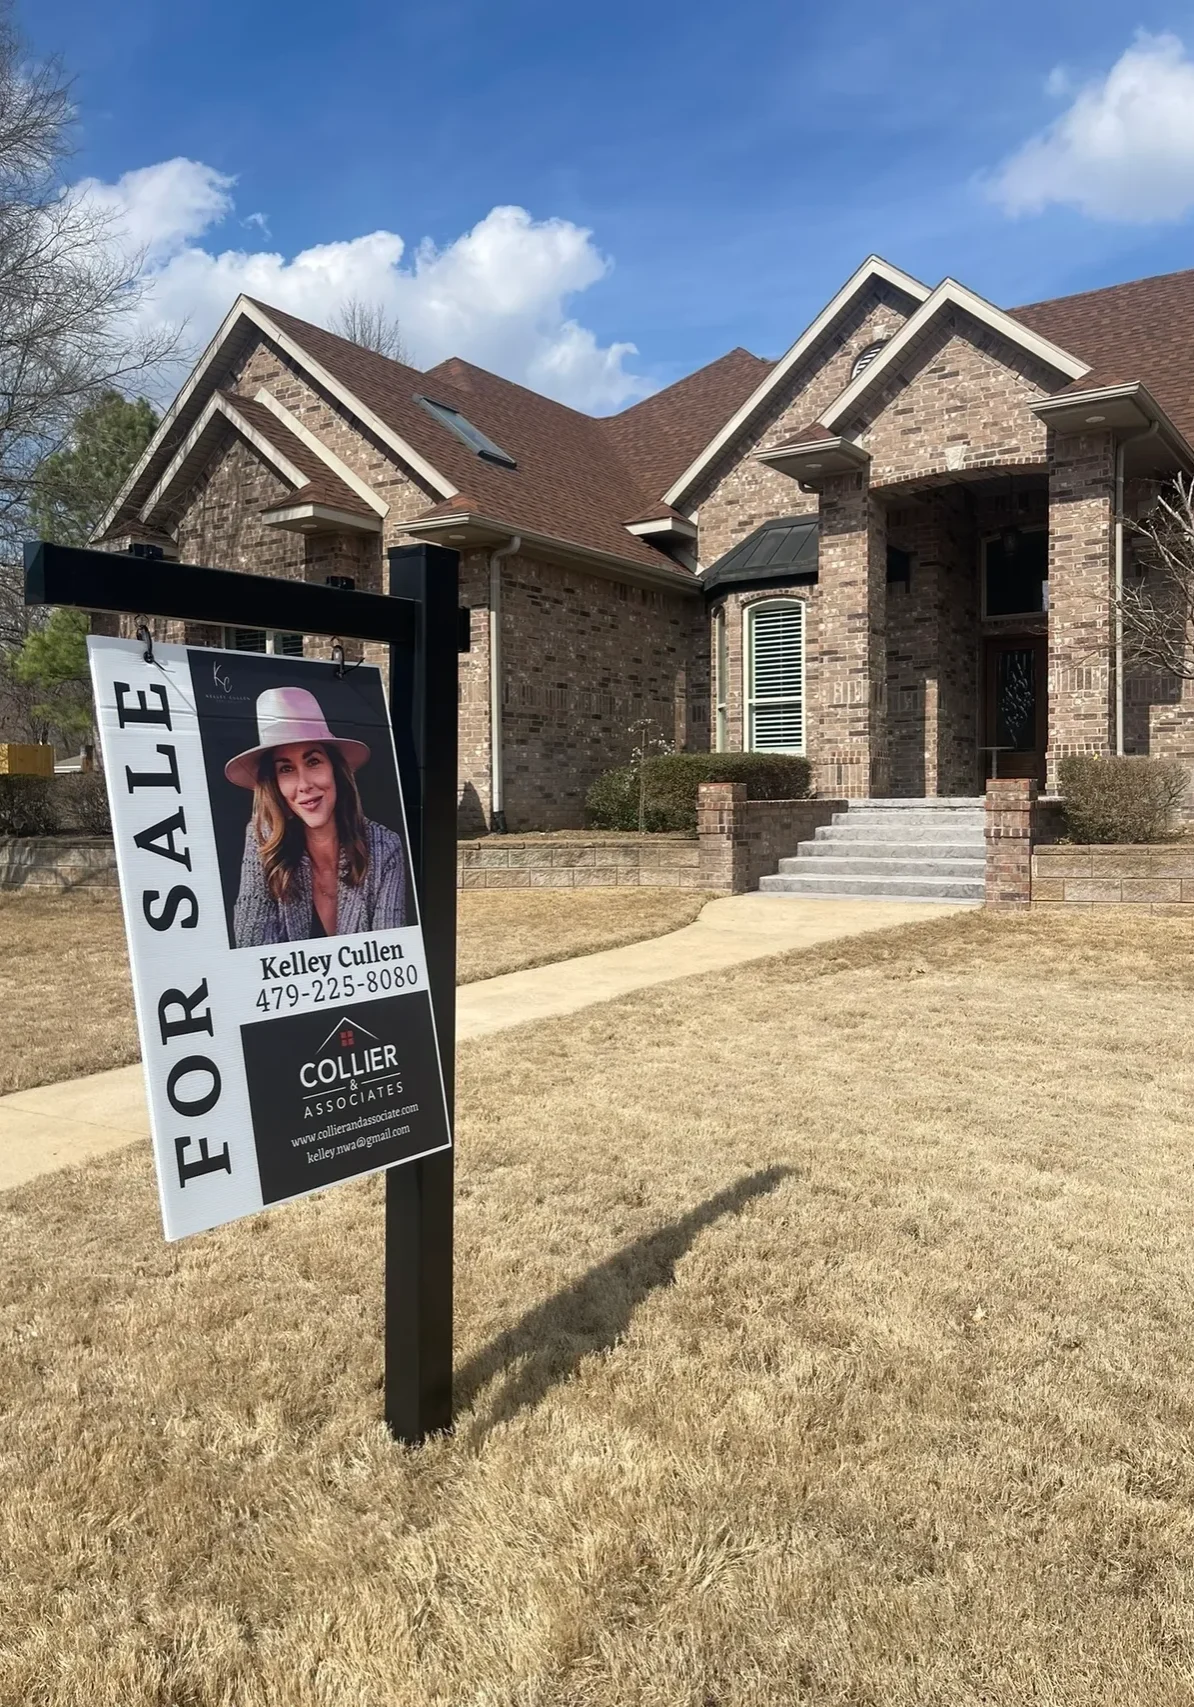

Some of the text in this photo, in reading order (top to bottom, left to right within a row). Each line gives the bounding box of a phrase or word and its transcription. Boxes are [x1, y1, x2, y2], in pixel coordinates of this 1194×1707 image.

[113, 681, 232, 1188] FOR SALE
[260, 940, 404, 980] Kelley Cullen
[256, 964, 418, 1012] 479-225-8080
[299, 1044, 399, 1088] COLLIER
[350, 1079, 359, 1091] &
[304, 1081, 404, 1119] ASSOCIATES
[291, 1102, 419, 1147] www.collierandassociate.com
[307, 1128, 411, 1163] kelley.nwa@gmail.com
